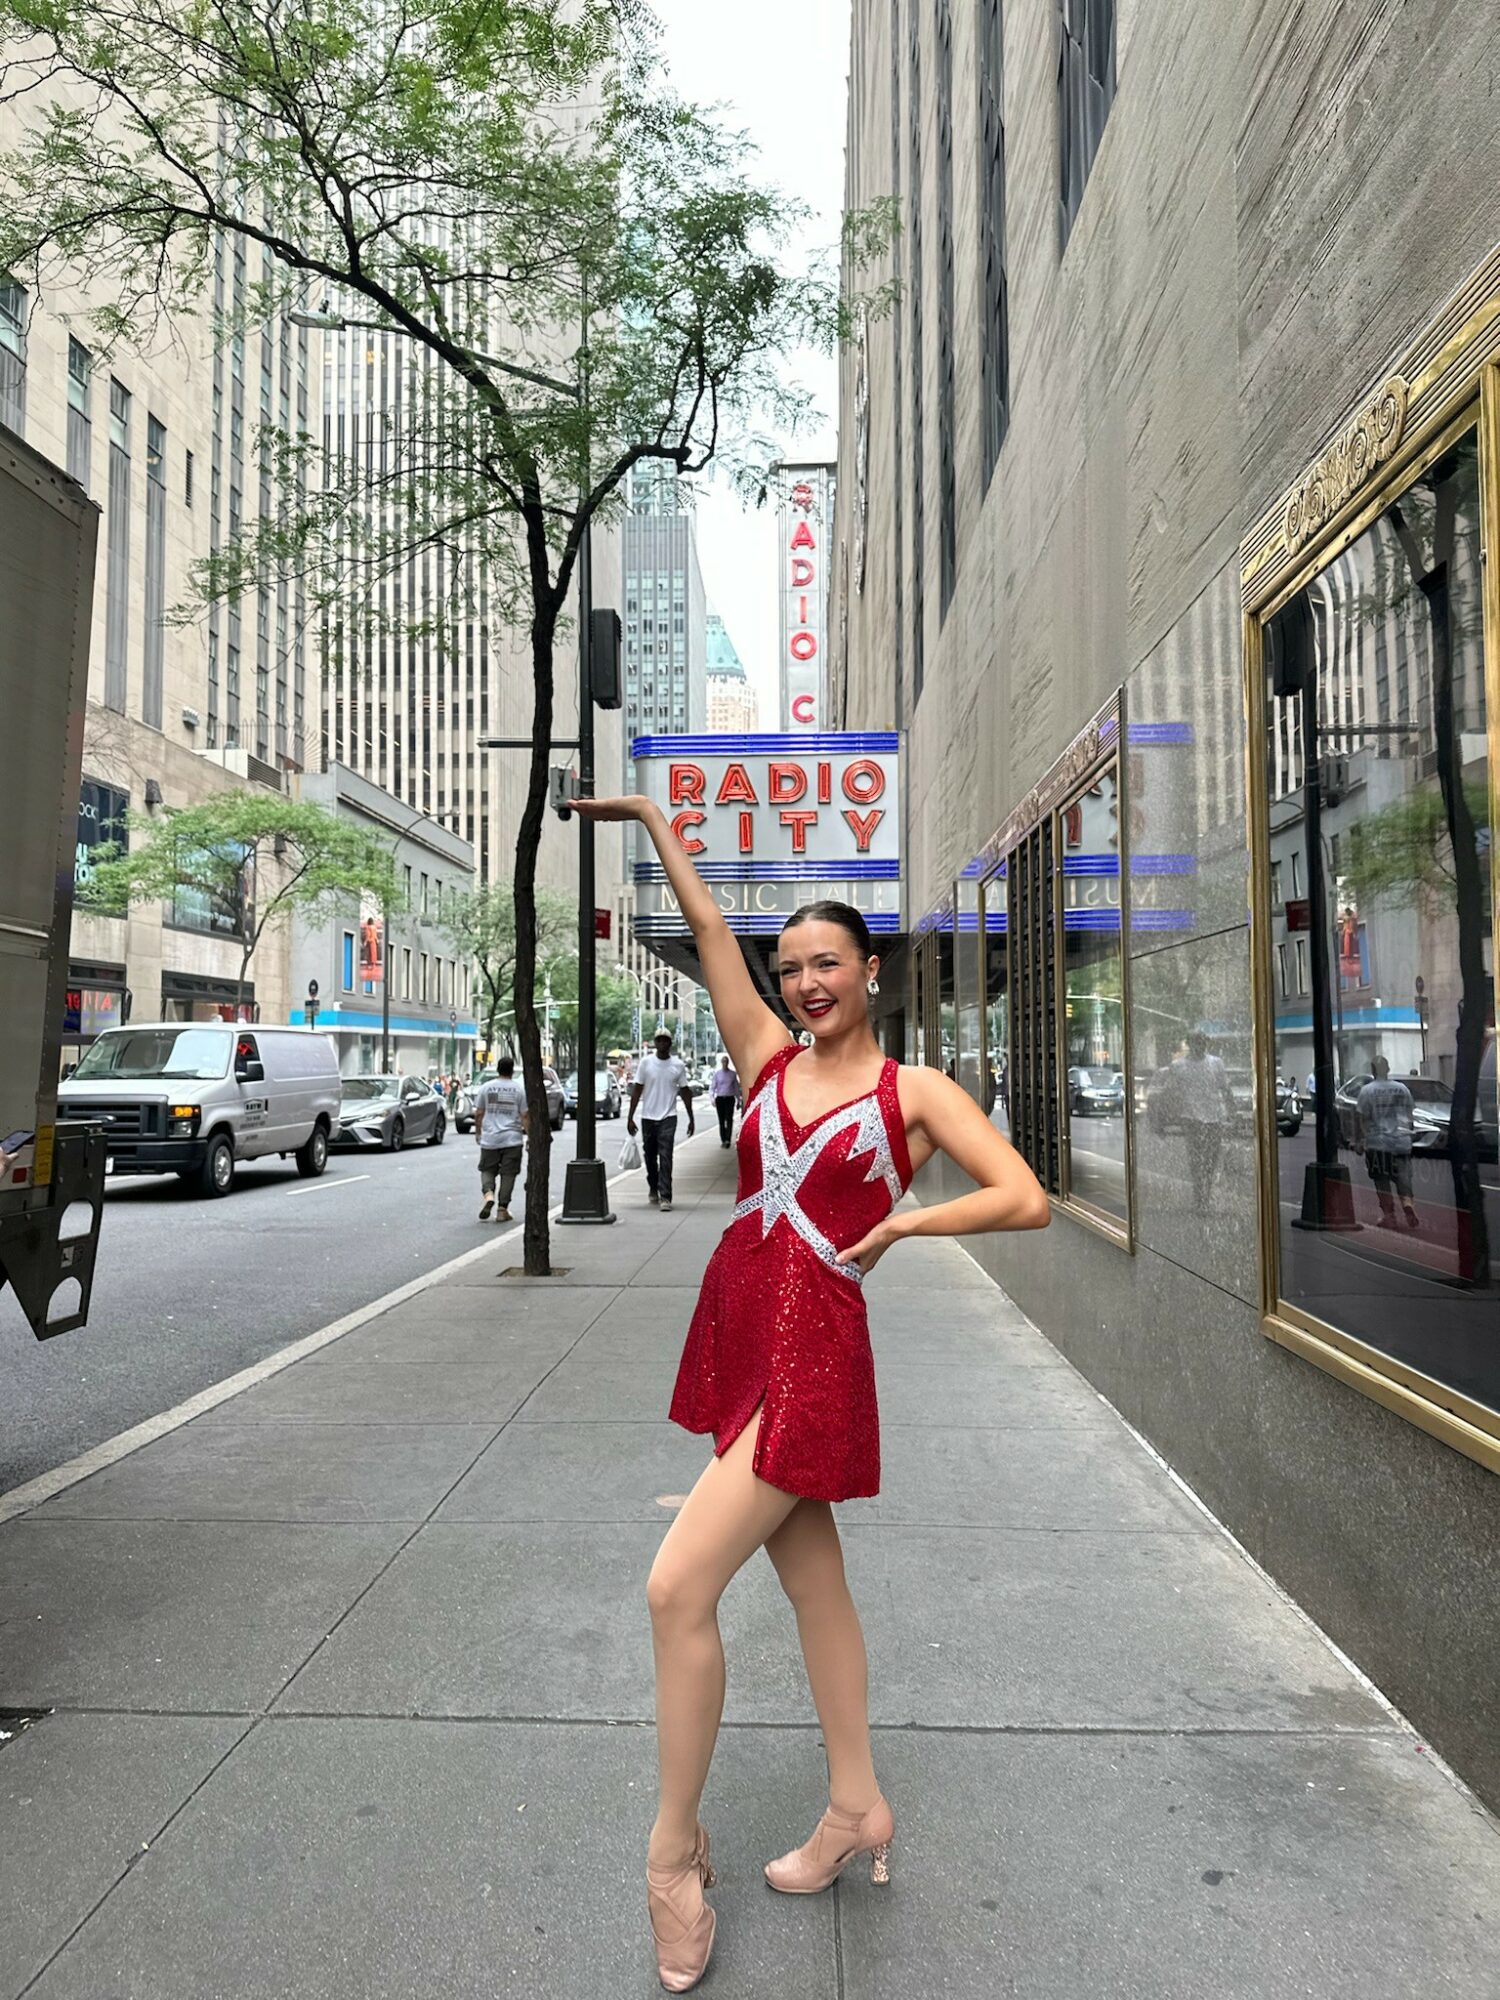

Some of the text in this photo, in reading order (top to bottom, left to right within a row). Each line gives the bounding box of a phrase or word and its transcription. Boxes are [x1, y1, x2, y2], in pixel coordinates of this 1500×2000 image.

[790, 483, 817, 660] RADIO
[669, 758, 886, 805] RADIO
[78, 802, 97, 819] OCK
[670, 809, 886, 855] CITY
[661, 883, 897, 912] MSIC HALL
